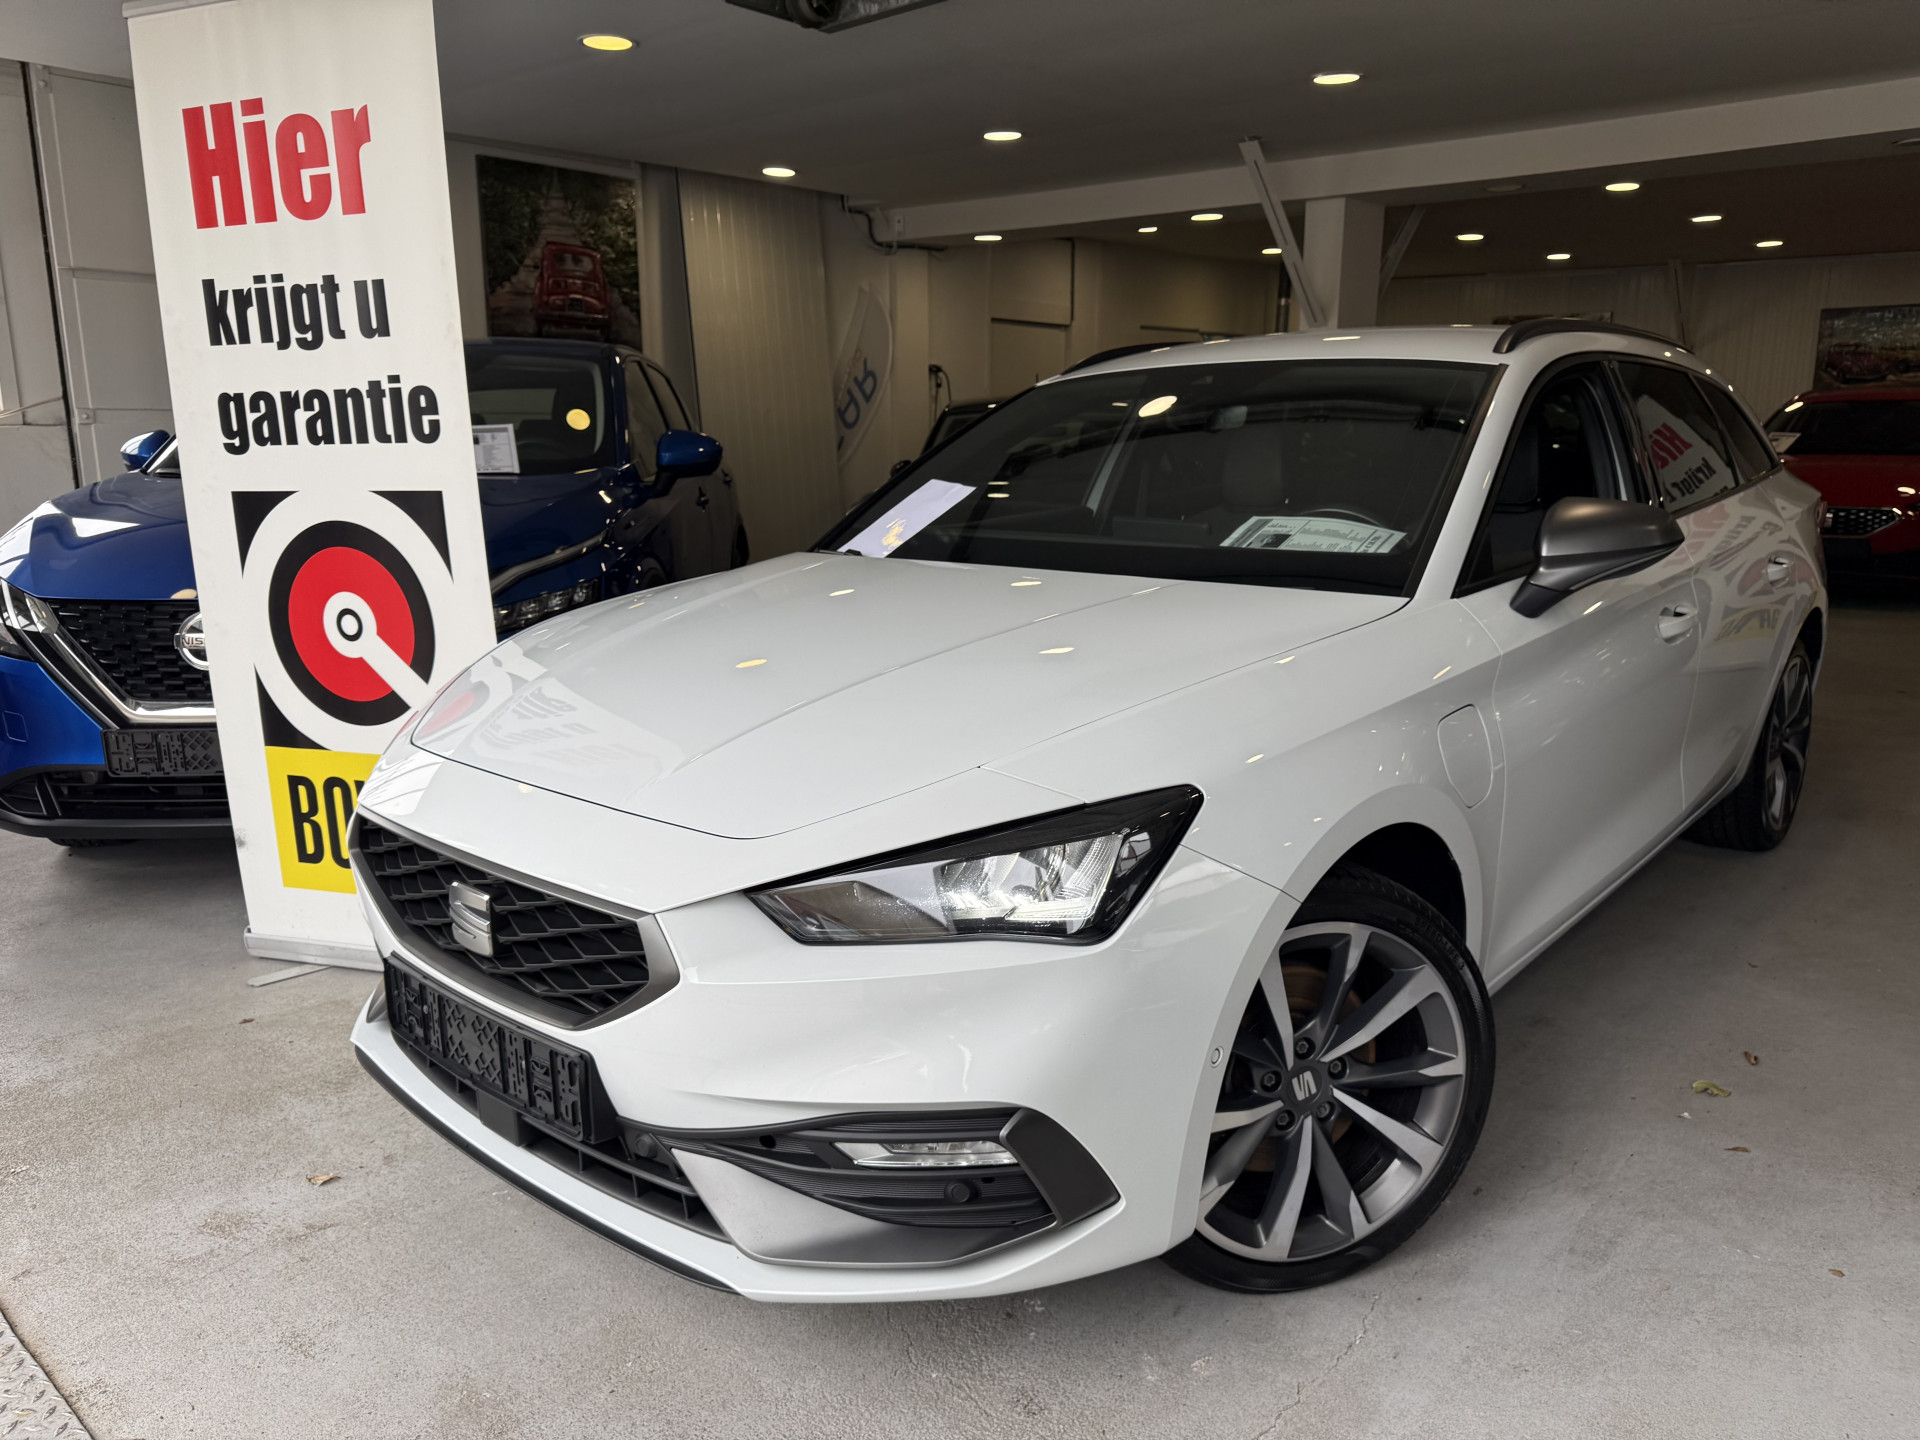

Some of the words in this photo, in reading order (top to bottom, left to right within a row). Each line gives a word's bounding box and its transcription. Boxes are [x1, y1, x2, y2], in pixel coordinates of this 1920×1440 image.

[182, 98, 371, 229] Hier
[202, 274, 346, 350] krijgt
[354, 279, 390, 338] u
[218, 375, 441, 456] garantie
[182, 637, 204, 645] NIS
